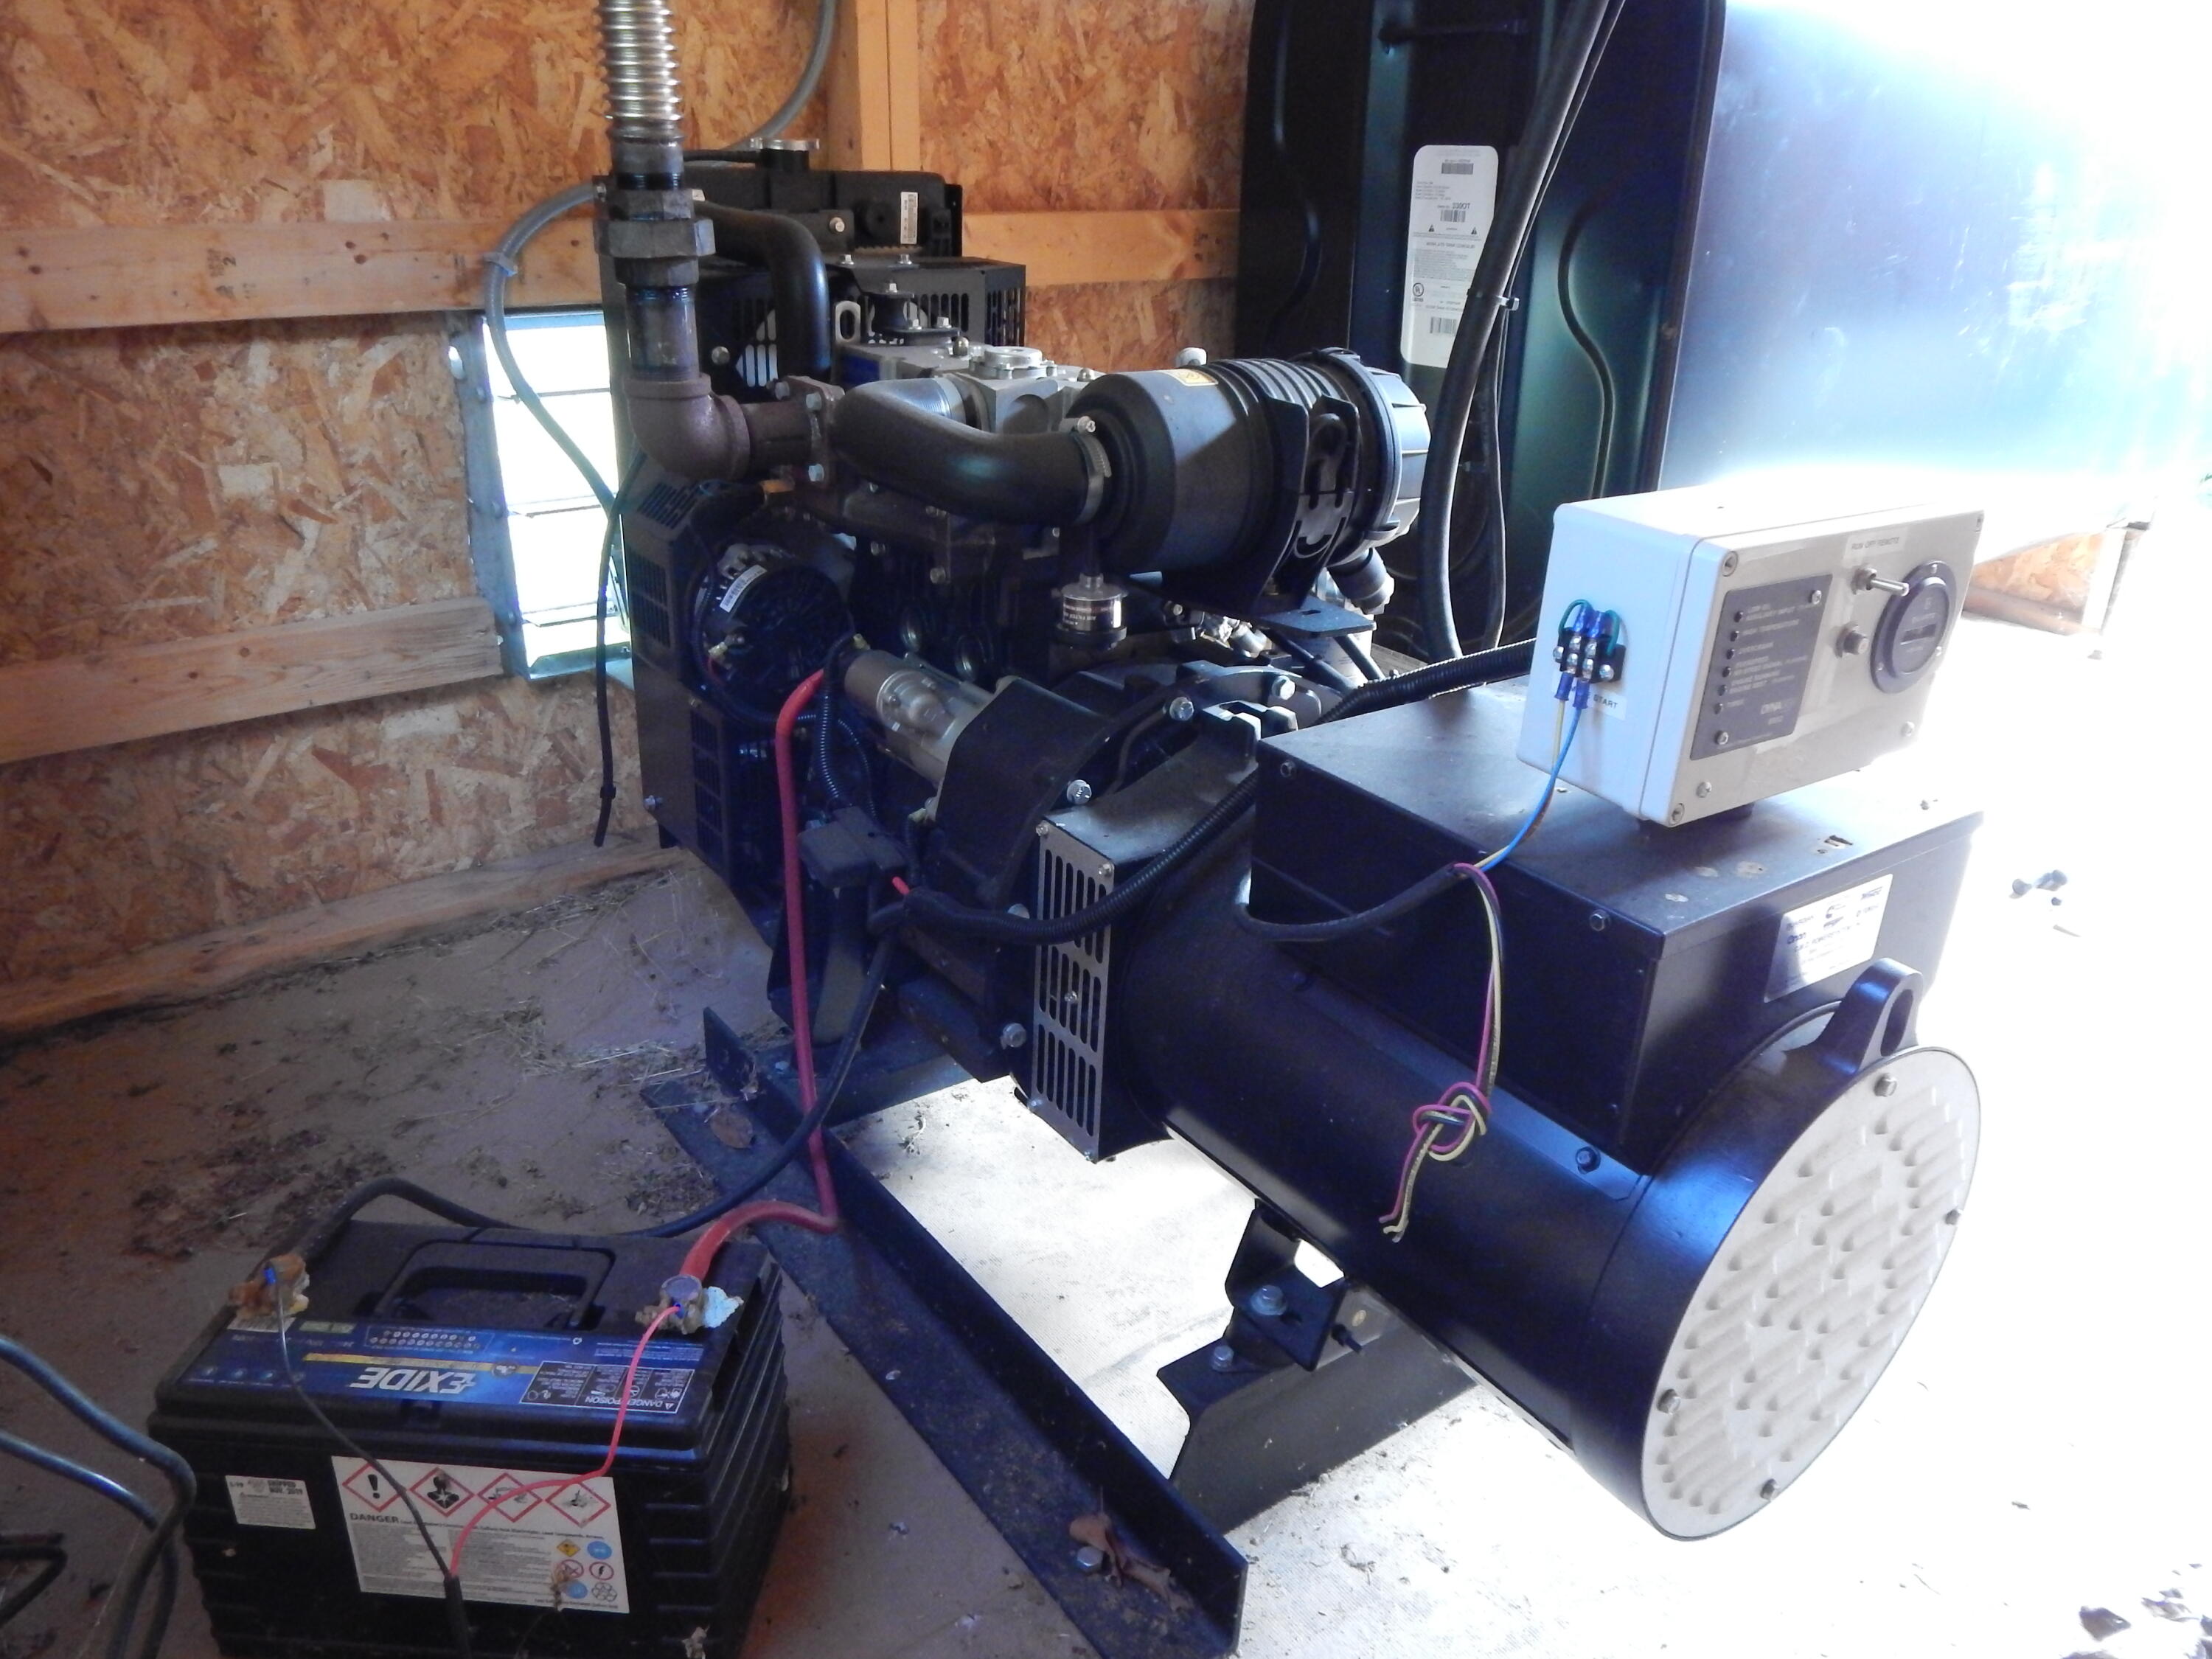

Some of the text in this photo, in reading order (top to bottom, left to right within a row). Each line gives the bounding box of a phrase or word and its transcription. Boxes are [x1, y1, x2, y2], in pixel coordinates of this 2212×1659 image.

[1593, 694, 1618, 709] START
[348, 1366, 476, 1394] EXIDE
[624, 1398, 664, 1408] DANGE
[349, 1512, 399, 1523] DANGER
